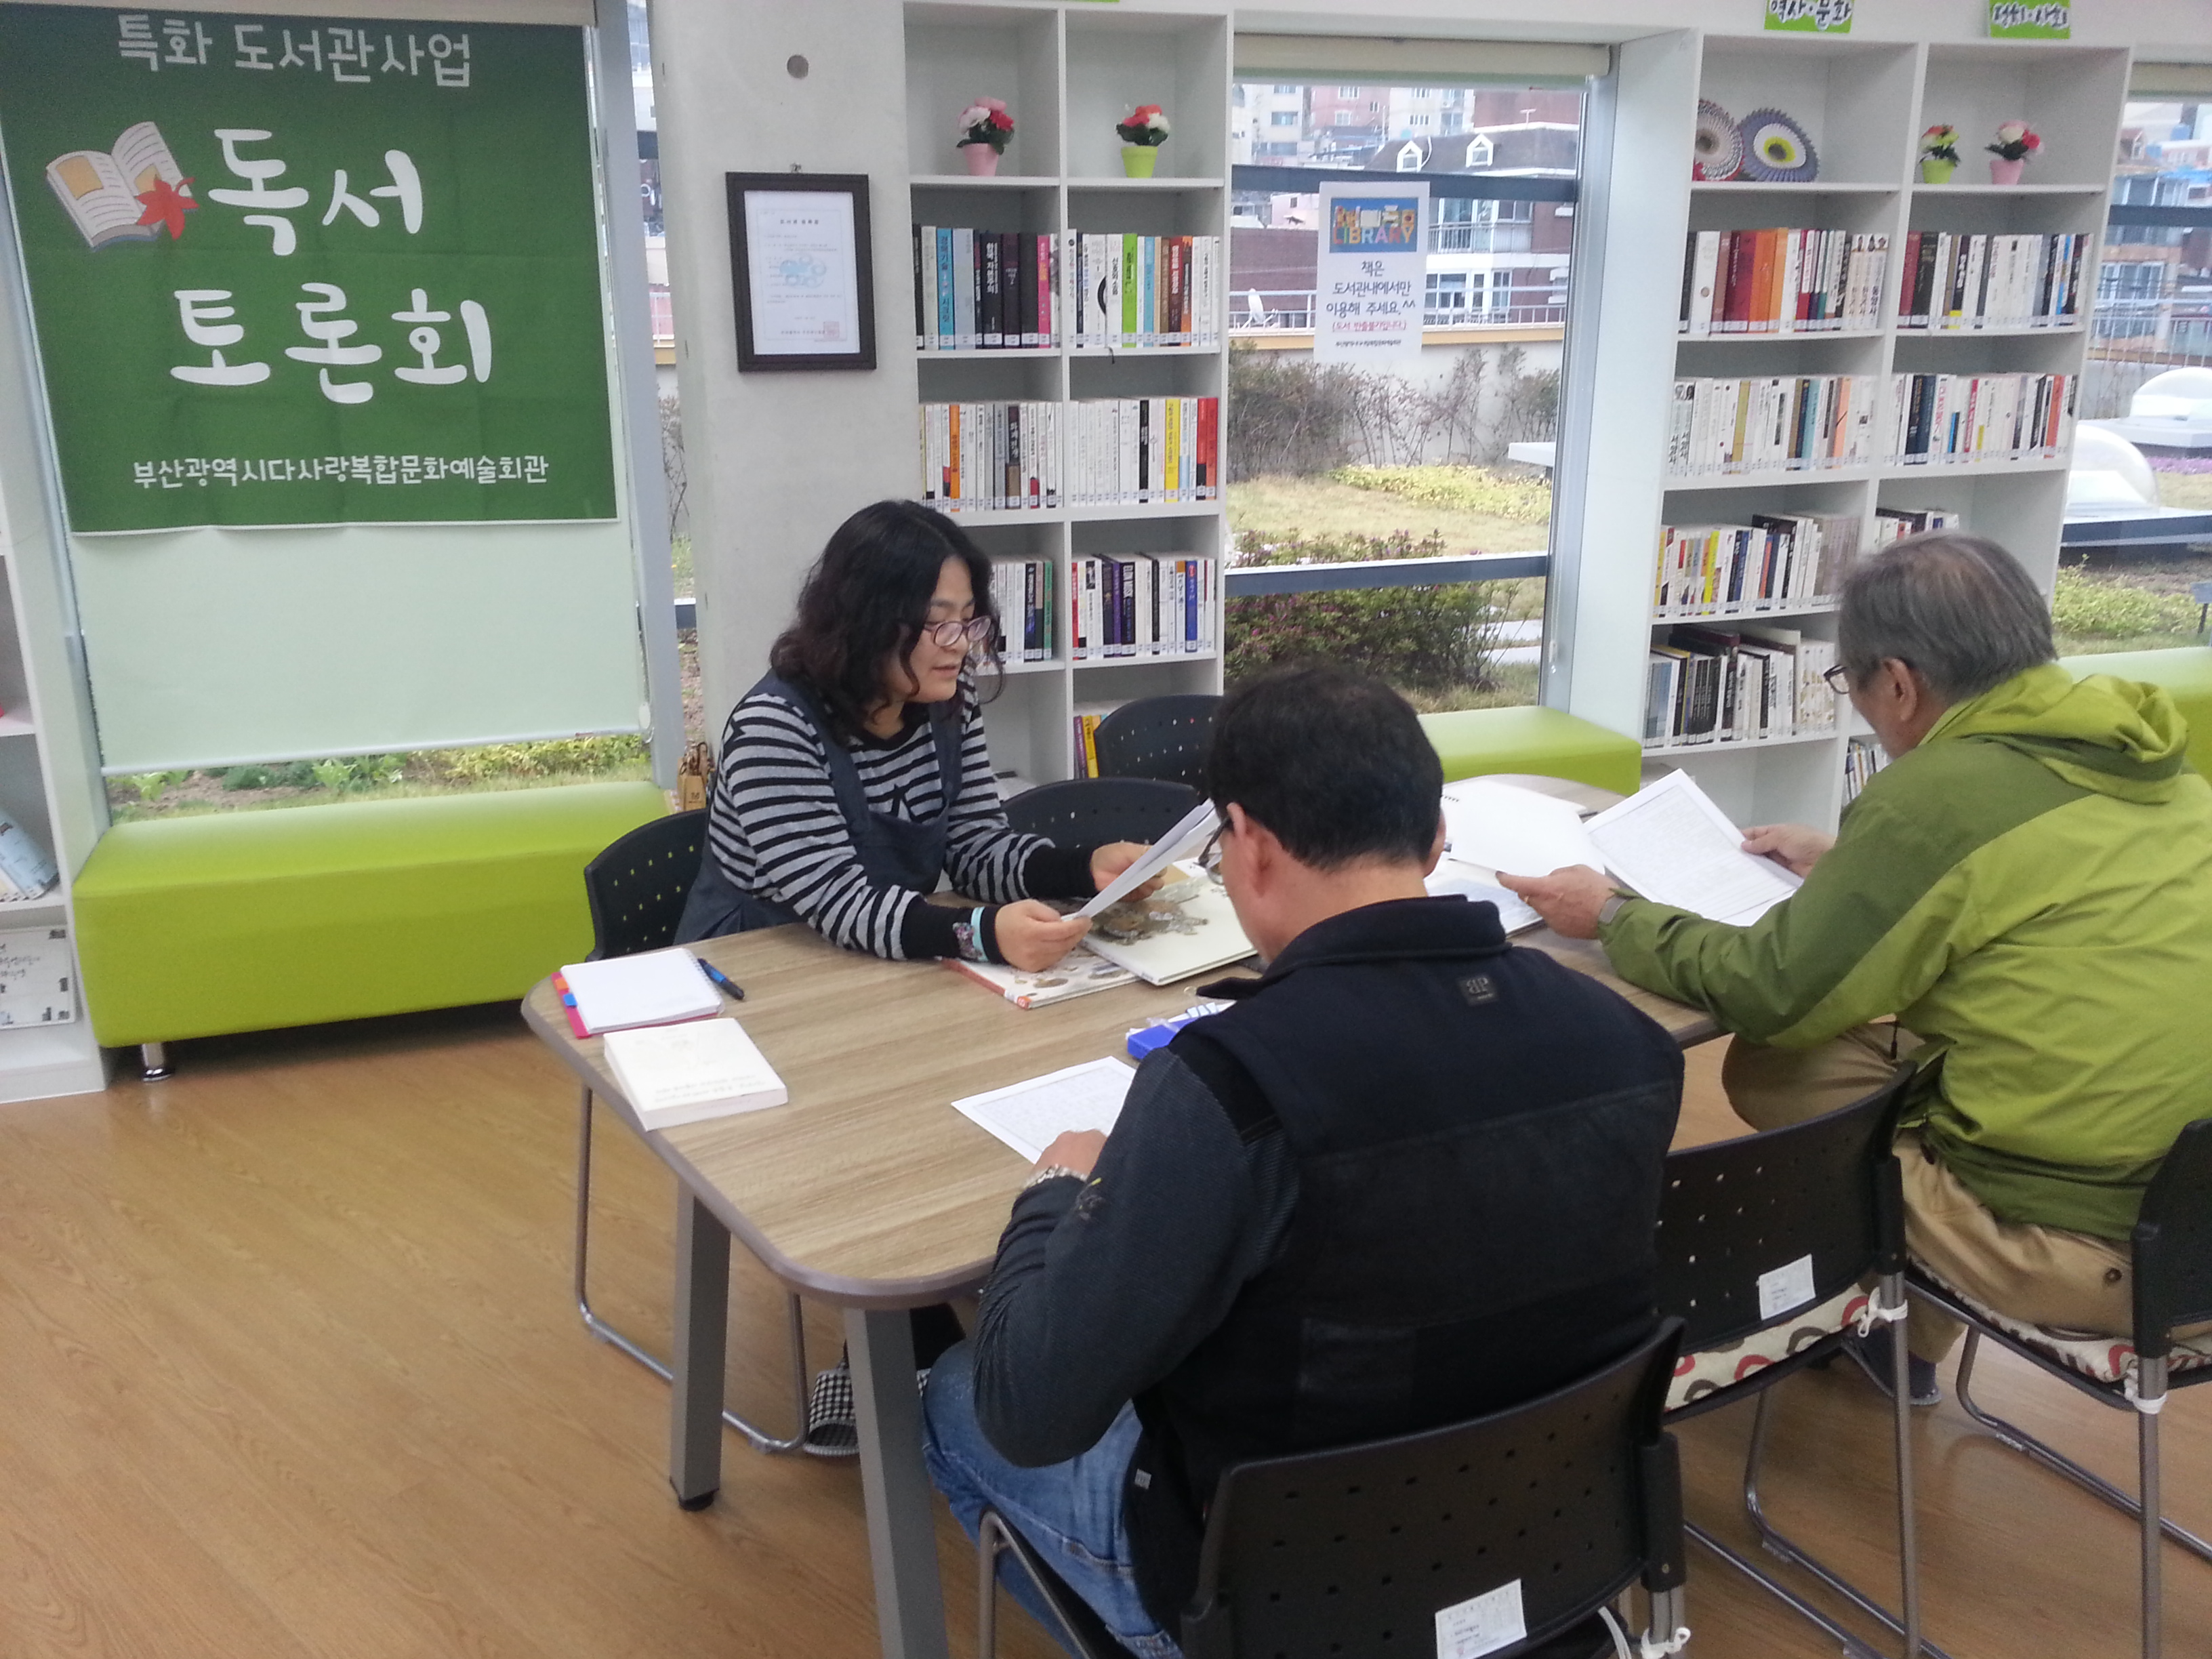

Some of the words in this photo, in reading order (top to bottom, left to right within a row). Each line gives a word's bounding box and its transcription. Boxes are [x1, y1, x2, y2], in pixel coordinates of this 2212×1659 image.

[118, 14, 211, 71] 특화
[234, 24, 470, 87] 도서관사업
[207, 128, 424, 256] 독서
[1333, 225, 1414, 244] LIBRARY
[1361, 260, 1385, 277] 책은
[1332, 280, 1412, 298] 도서관내에서만
[1326, 301, 1361, 319] 이용해
[169, 282, 493, 405] 토론회
